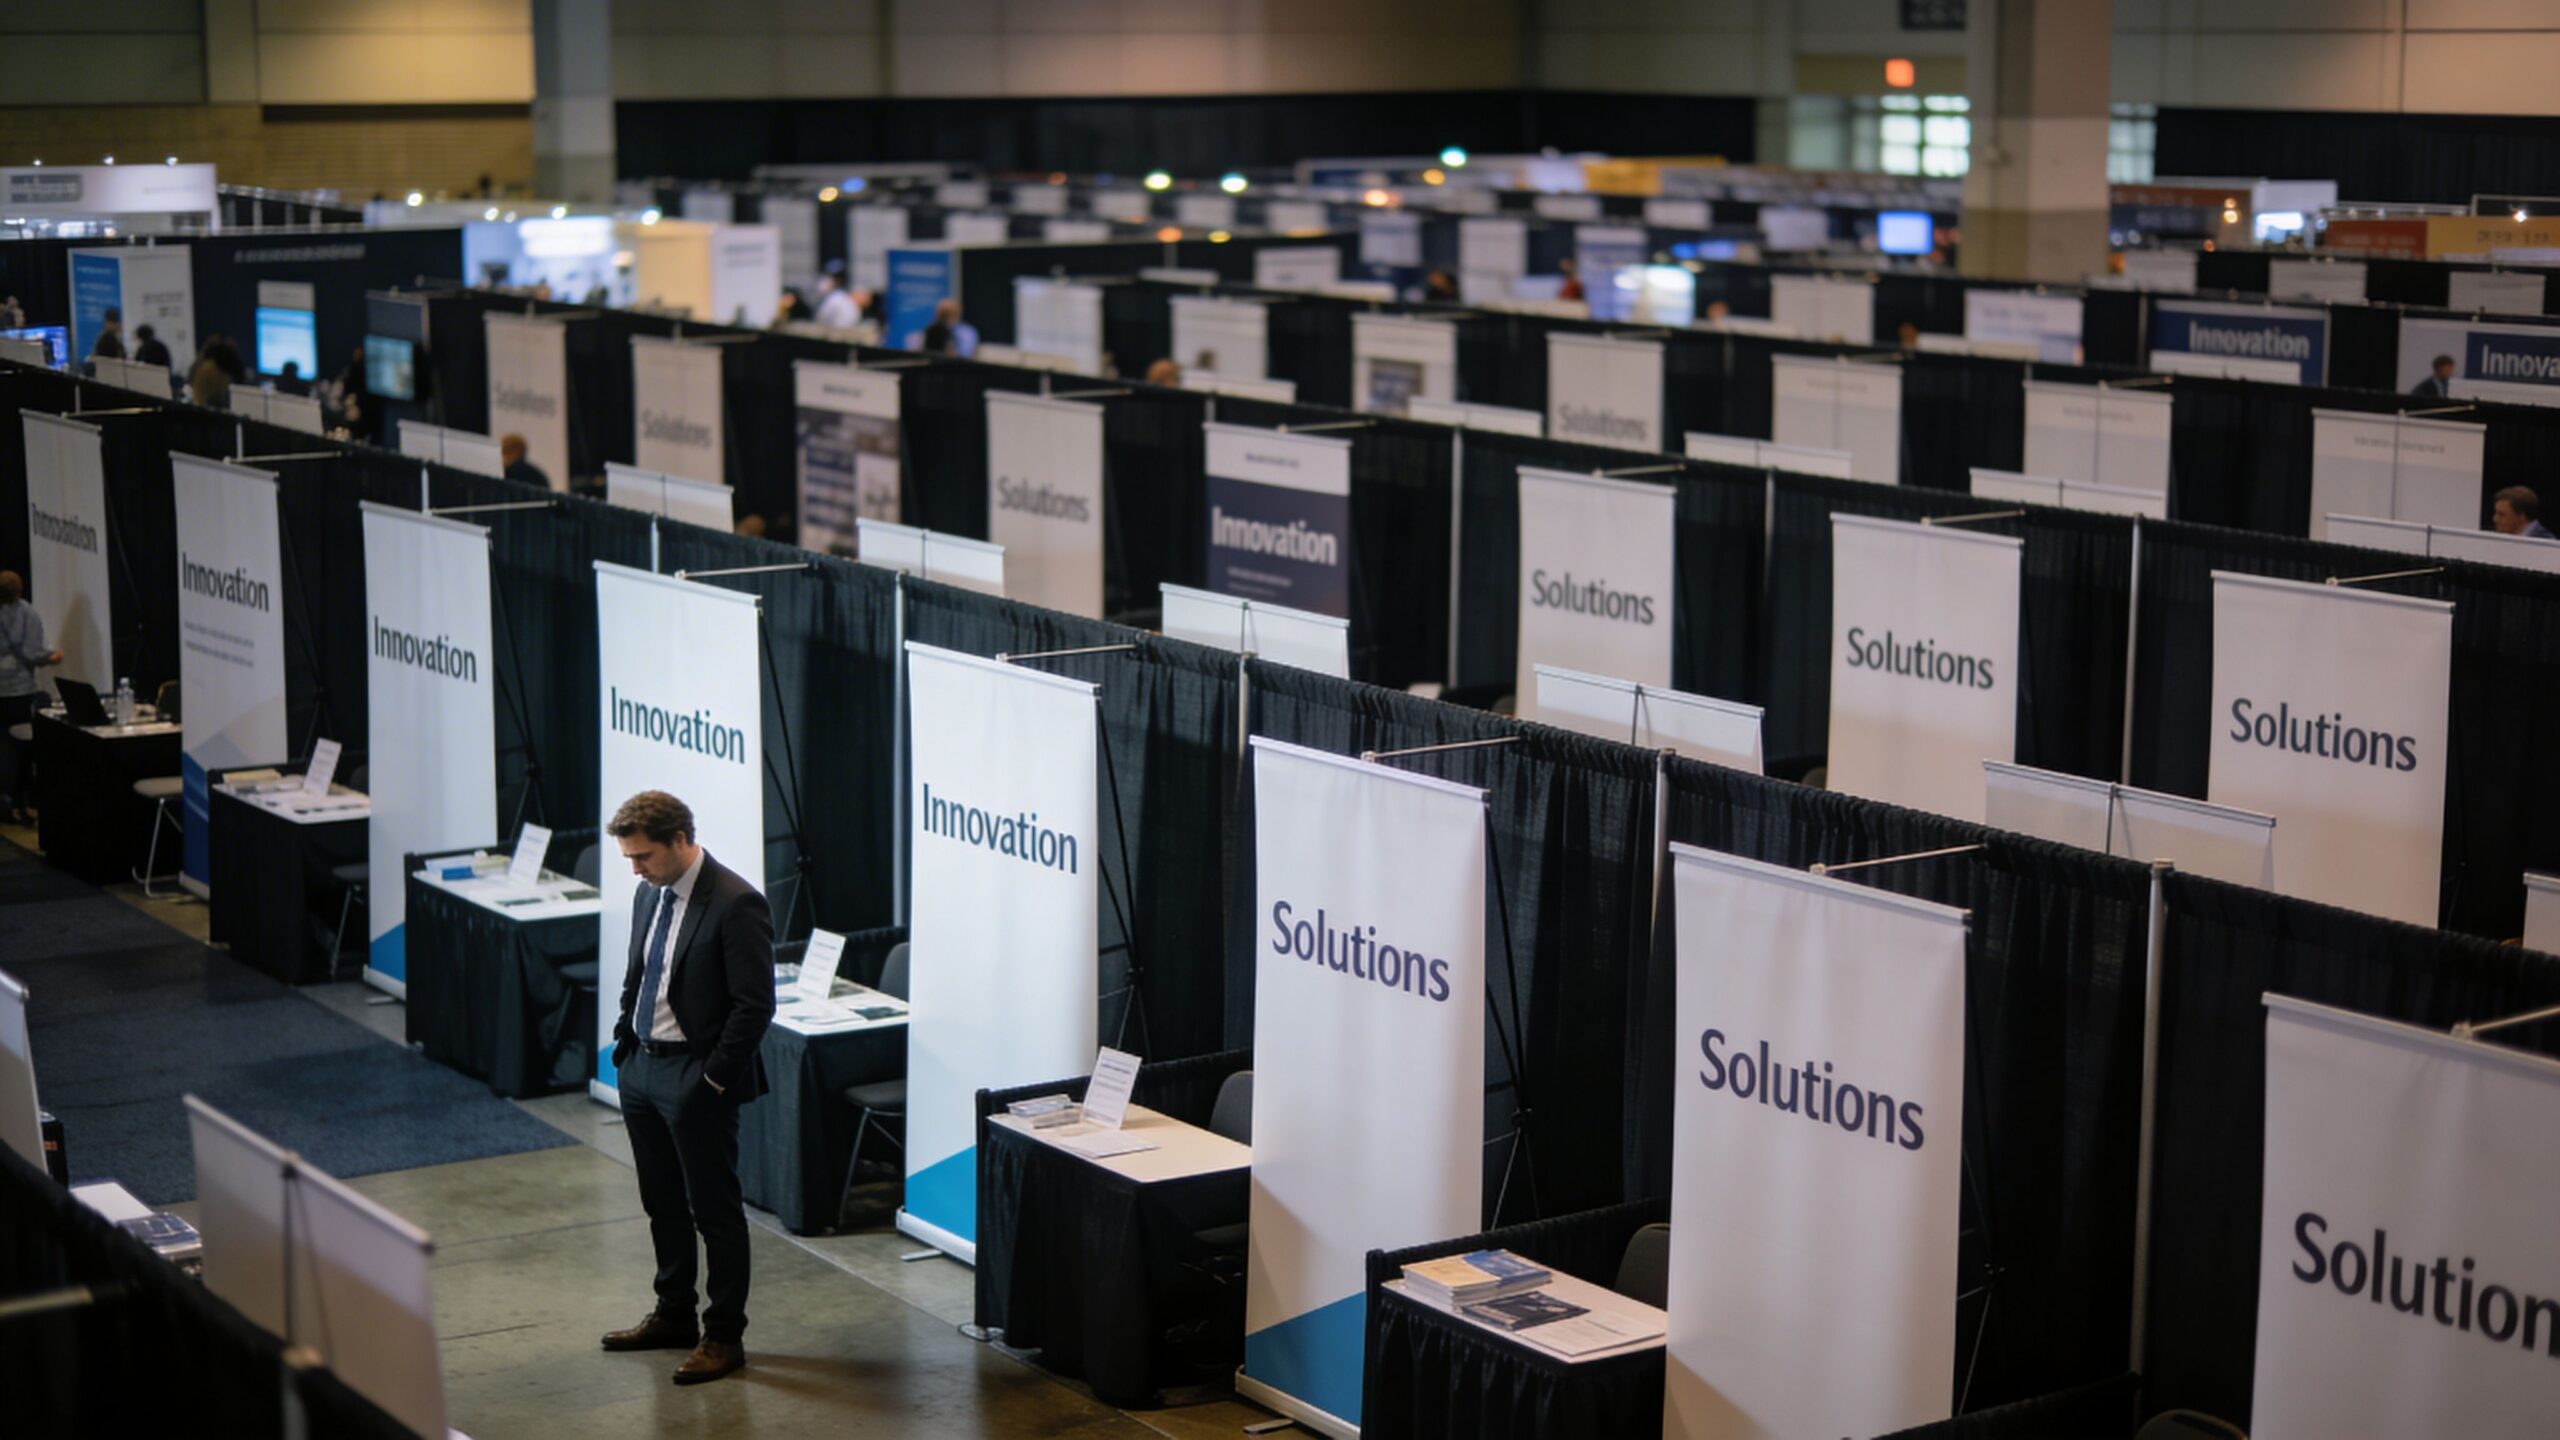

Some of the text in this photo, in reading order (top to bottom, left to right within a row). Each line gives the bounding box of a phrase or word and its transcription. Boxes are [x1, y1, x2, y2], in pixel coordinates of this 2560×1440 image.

[2188, 319, 2311, 359] Innovation
[2481, 344, 2560, 378] Innova
[998, 475, 1091, 524] Solutions
[1211, 505, 1338, 566] Innovation
[182, 552, 269, 612] Innovation
[1532, 569, 1655, 625] Solutions
[374, 615, 477, 683] Innovation
[1847, 627, 1994, 690] Solutions
[611, 686, 745, 764] Innovation
[2230, 698, 2417, 772] Solutions
[923, 783, 1077, 874] Innovation
[1272, 900, 1450, 1002] Solutions
[1700, 1028, 1925, 1150] Solutions
[2293, 1212, 2560, 1359] Solution
